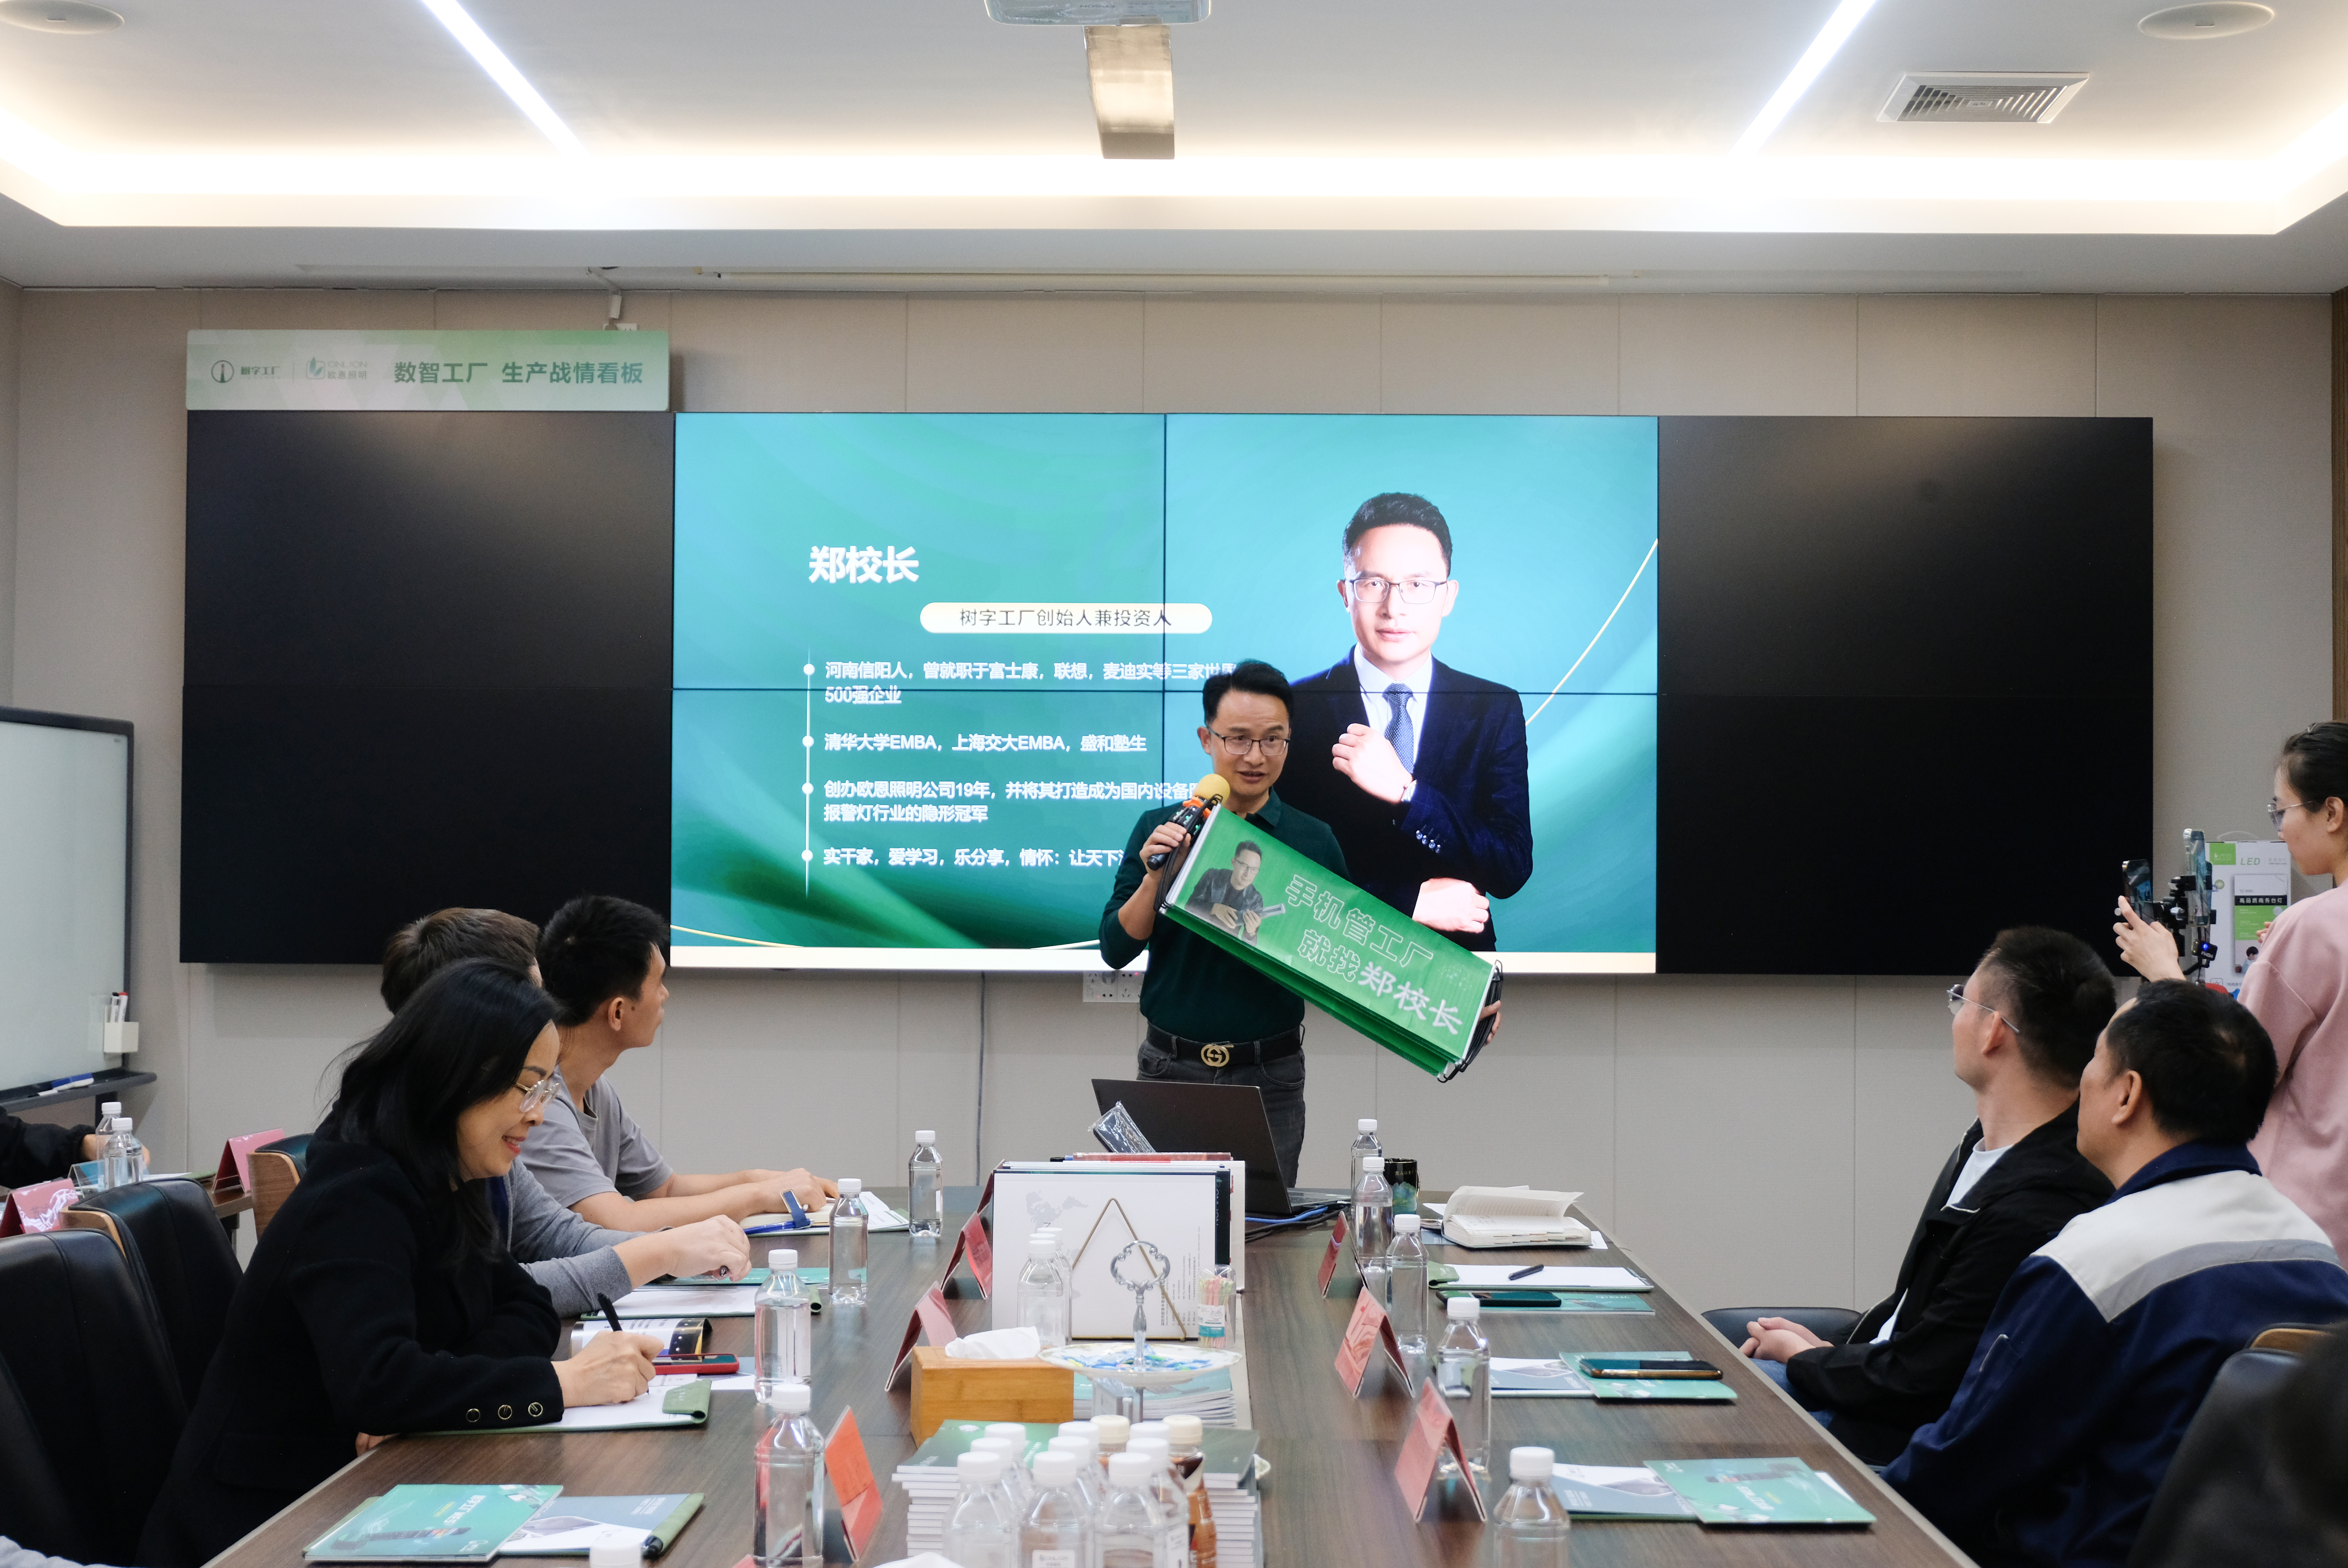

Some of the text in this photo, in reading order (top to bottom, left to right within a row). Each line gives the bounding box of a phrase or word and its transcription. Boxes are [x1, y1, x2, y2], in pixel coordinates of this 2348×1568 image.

[394, 361, 643, 384] 数智工厂 生产战情看板
[809, 545, 919, 584] 郑校长
[959, 608, 1172, 627] 树字工厂创始人兼投资人
[825, 685, 902, 705] 500强企业
[823, 803, 988, 822] 报警灯行业的隐形冠军
[823, 847, 1124, 867] 实干家，爱学习，乐分享，情怀：让天下
[1285, 874, 1434, 968] 手机管工厂
[1297, 929, 1463, 1035] 就找郑校长
